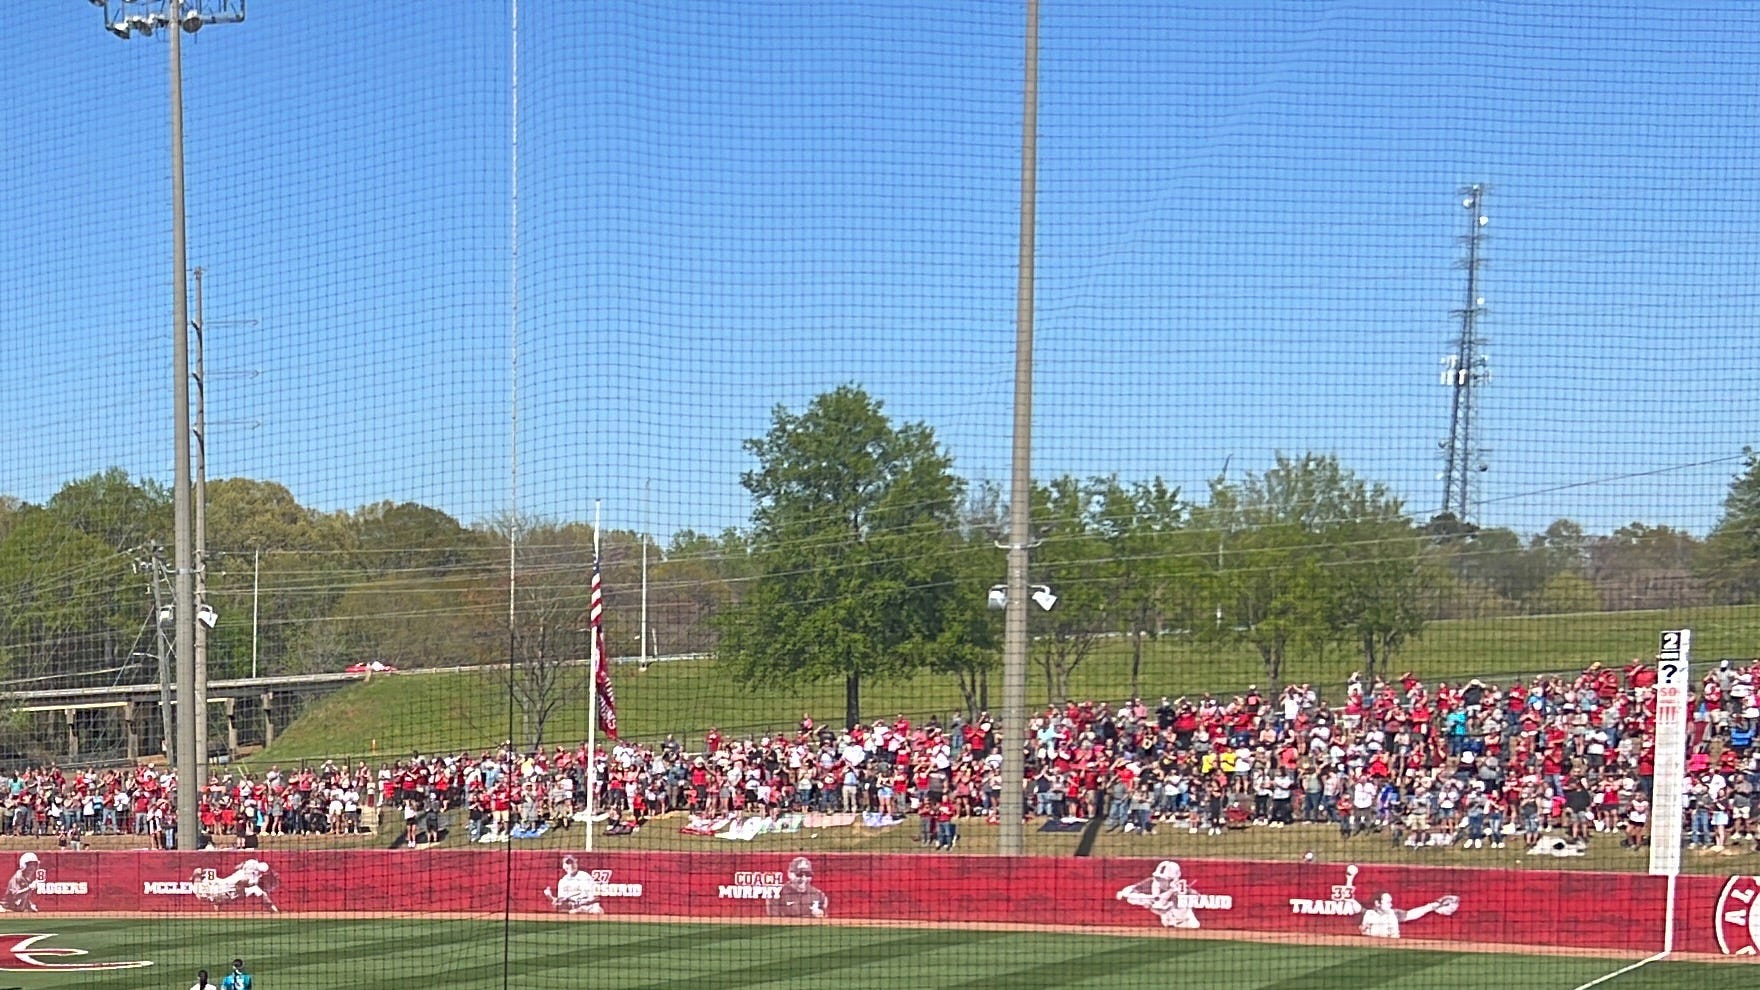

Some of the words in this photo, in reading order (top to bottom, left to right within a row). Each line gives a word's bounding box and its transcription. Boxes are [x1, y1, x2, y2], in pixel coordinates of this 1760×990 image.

[1663, 633, 1678, 649] 2
[734, 872, 783, 886] COACH
[36, 882, 88, 895] ROGERS
[718, 885, 783, 899] MURPHY
[1290, 898, 1357, 915] TRAINA
